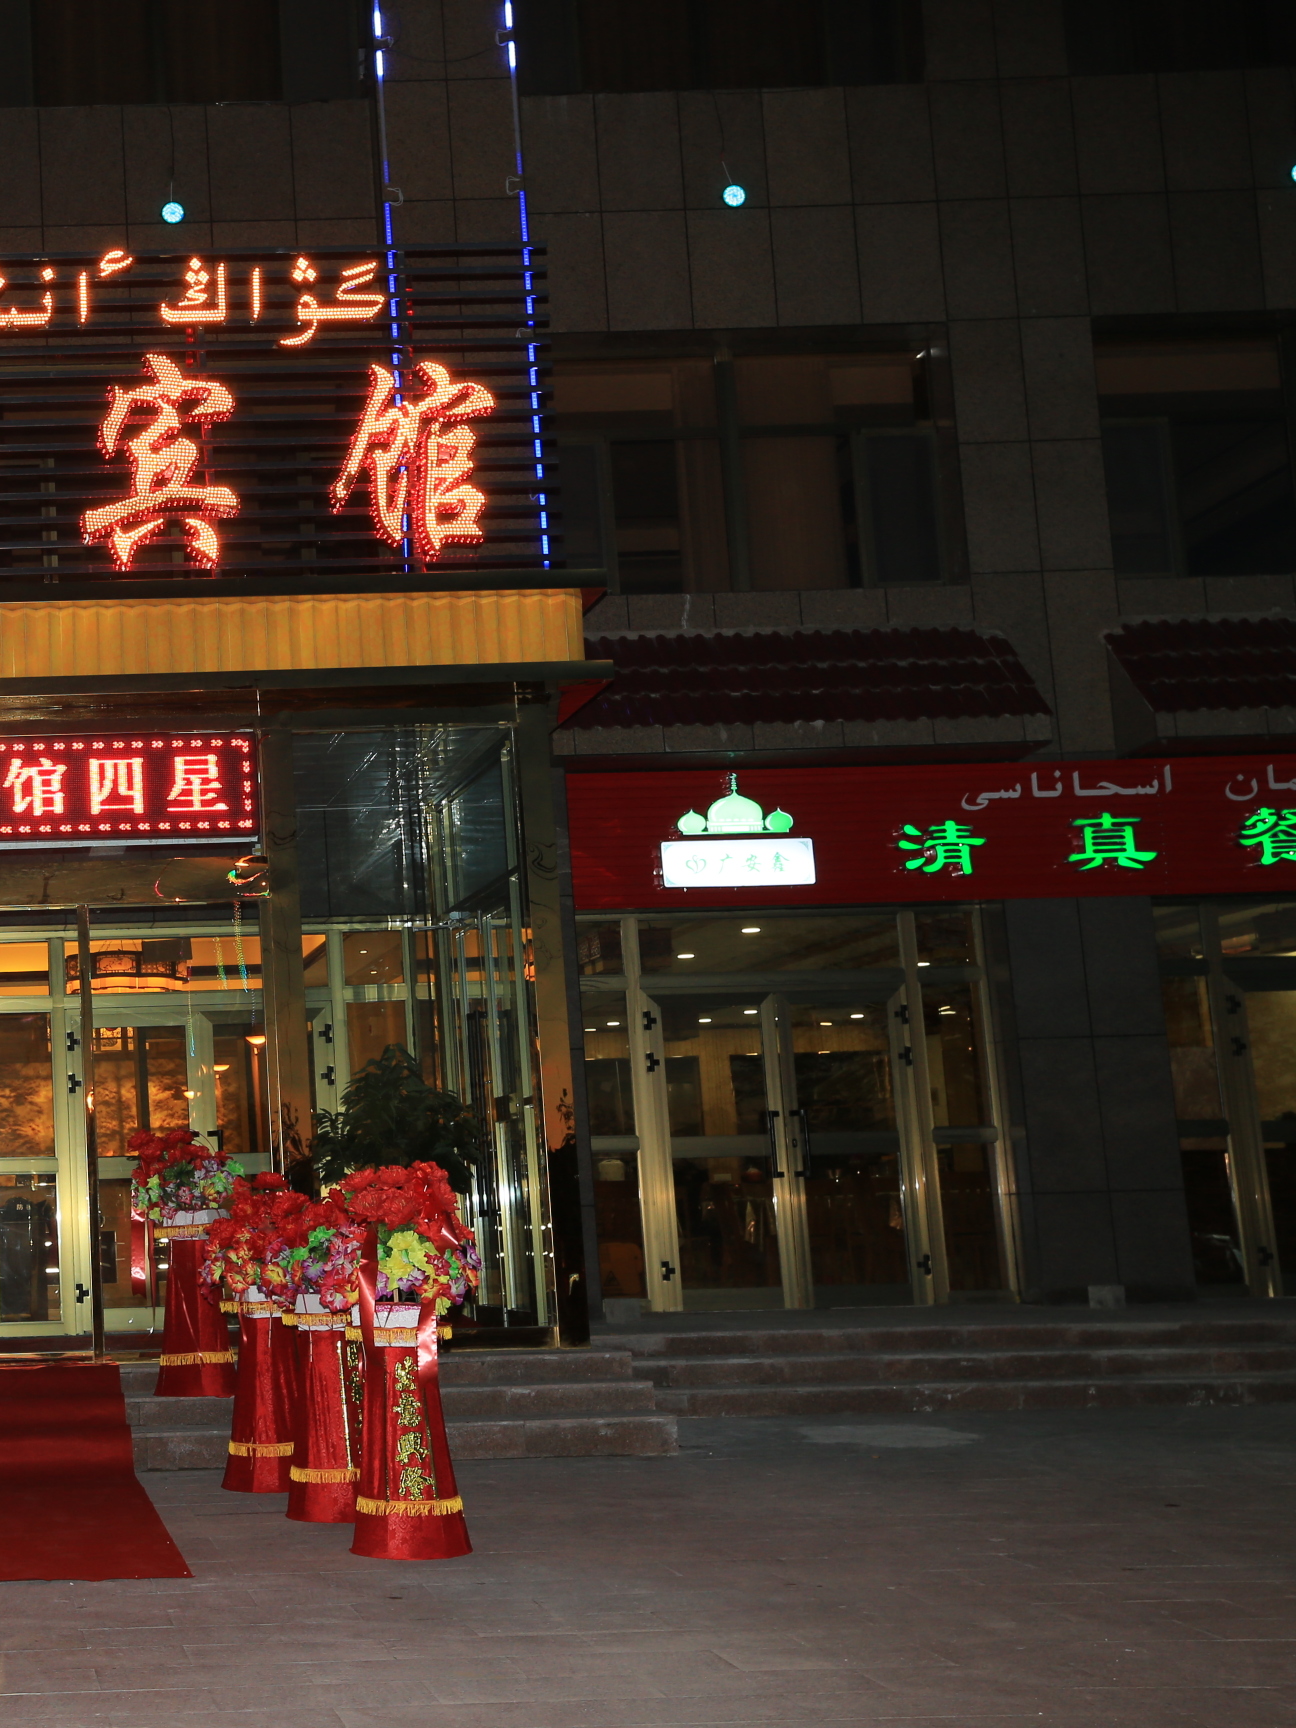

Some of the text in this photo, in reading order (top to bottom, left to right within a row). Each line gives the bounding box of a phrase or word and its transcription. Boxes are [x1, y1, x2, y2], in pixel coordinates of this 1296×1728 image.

[718, 851, 790, 874] 广安鑫
[898, 807, 1296, 875] 清真餐
